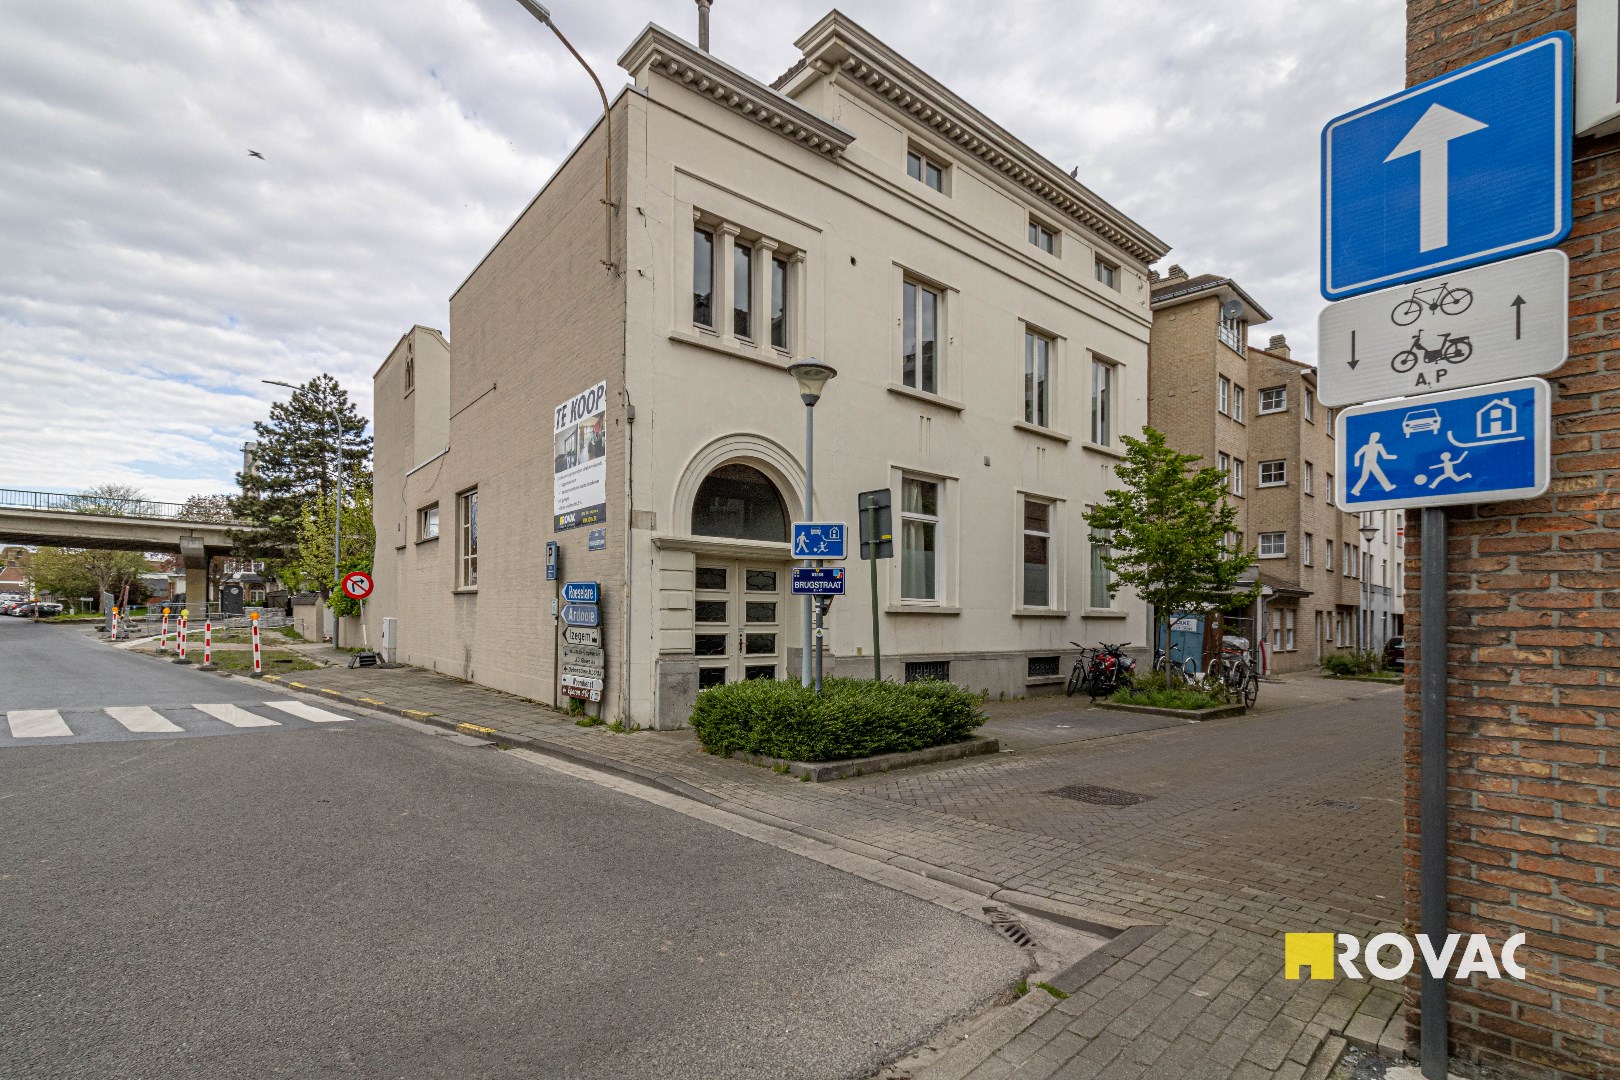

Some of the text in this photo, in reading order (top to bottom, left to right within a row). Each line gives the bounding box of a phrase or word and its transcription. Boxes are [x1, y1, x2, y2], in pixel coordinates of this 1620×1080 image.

[1436, 368, 1448, 383] P
[556, 385, 605, 430] TE KOOP
[568, 585, 594, 600] Roeselare
[794, 581, 842, 589] BRUGSTRAAT
[568, 607, 595, 622] Ardooie
[569, 628, 591, 643] Izegem
